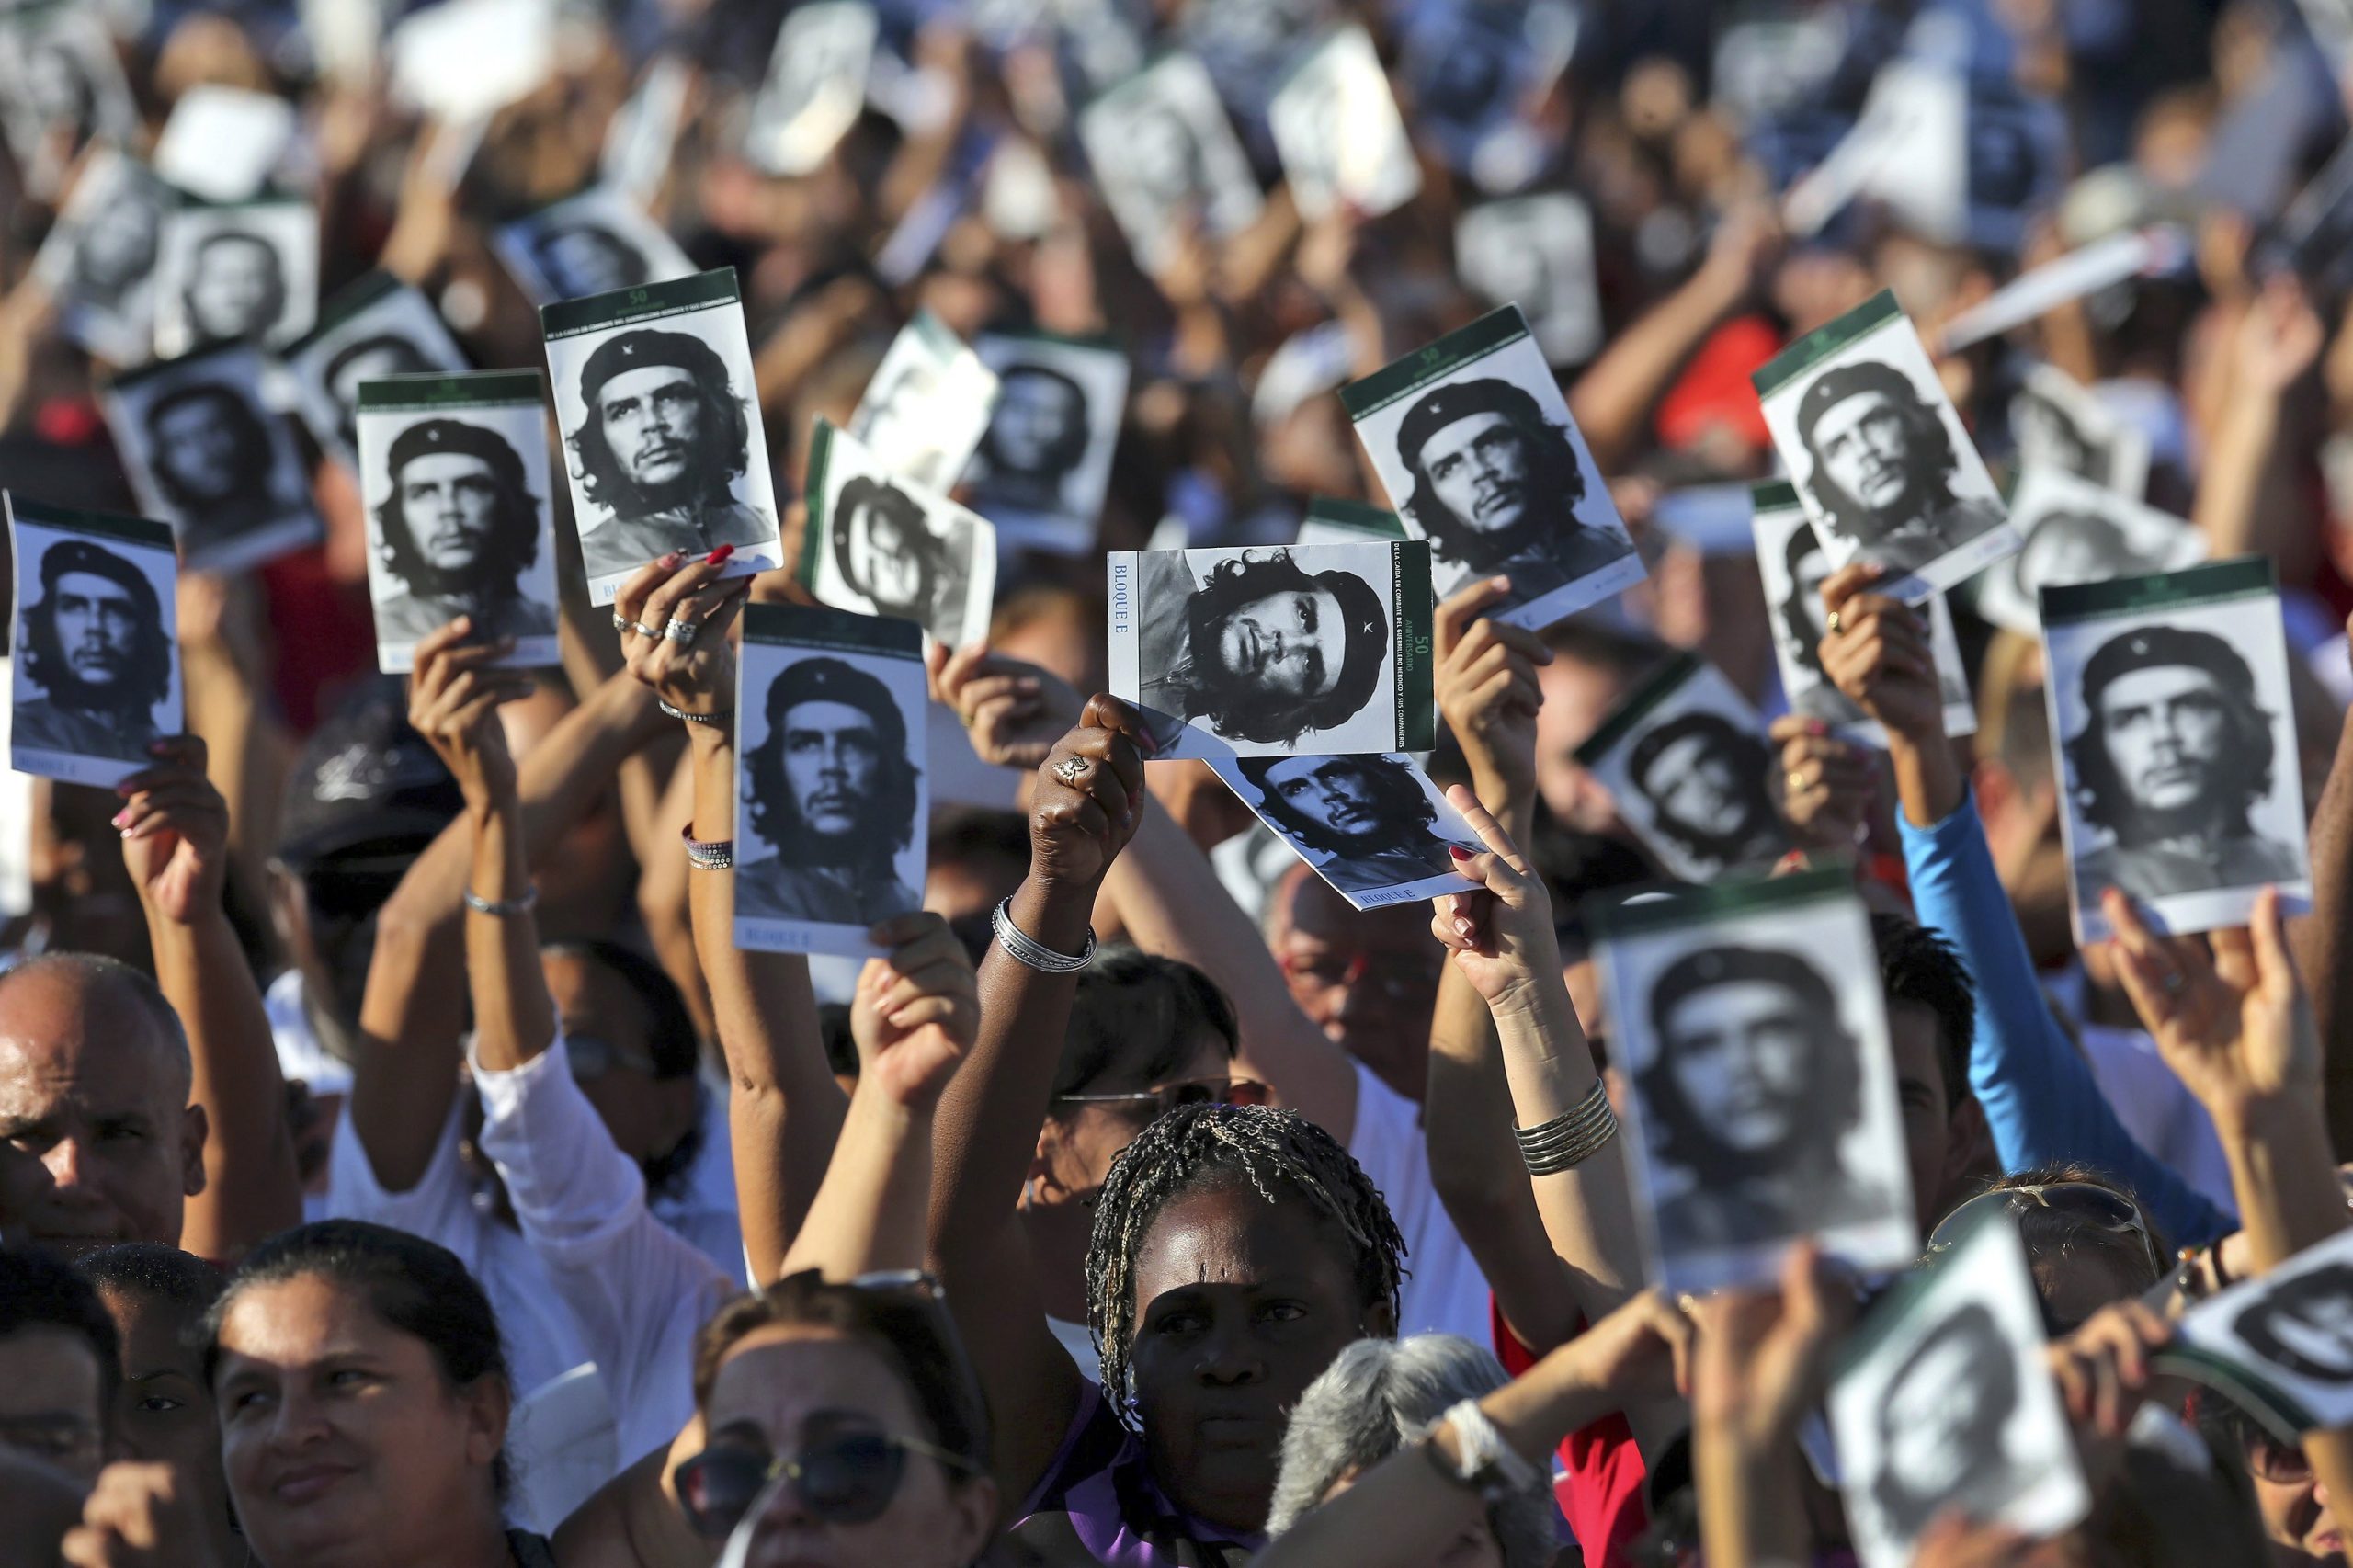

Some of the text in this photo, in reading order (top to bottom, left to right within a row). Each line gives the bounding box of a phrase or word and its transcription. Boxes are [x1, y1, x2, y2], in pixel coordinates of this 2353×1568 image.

[1393, 542, 1400, 551] DE
[1393, 551, 1401, 560] LA
[1394, 579, 1402, 587] EN
[1113, 565, 1128, 633] BLOQUE E
[1404, 619, 1414, 671] ANIVERSARIO
[1415, 636, 1429, 654] 50
[1397, 709, 1405, 748] COMPAÑEROS
[1360, 889, 1415, 903] BLOQUE E
